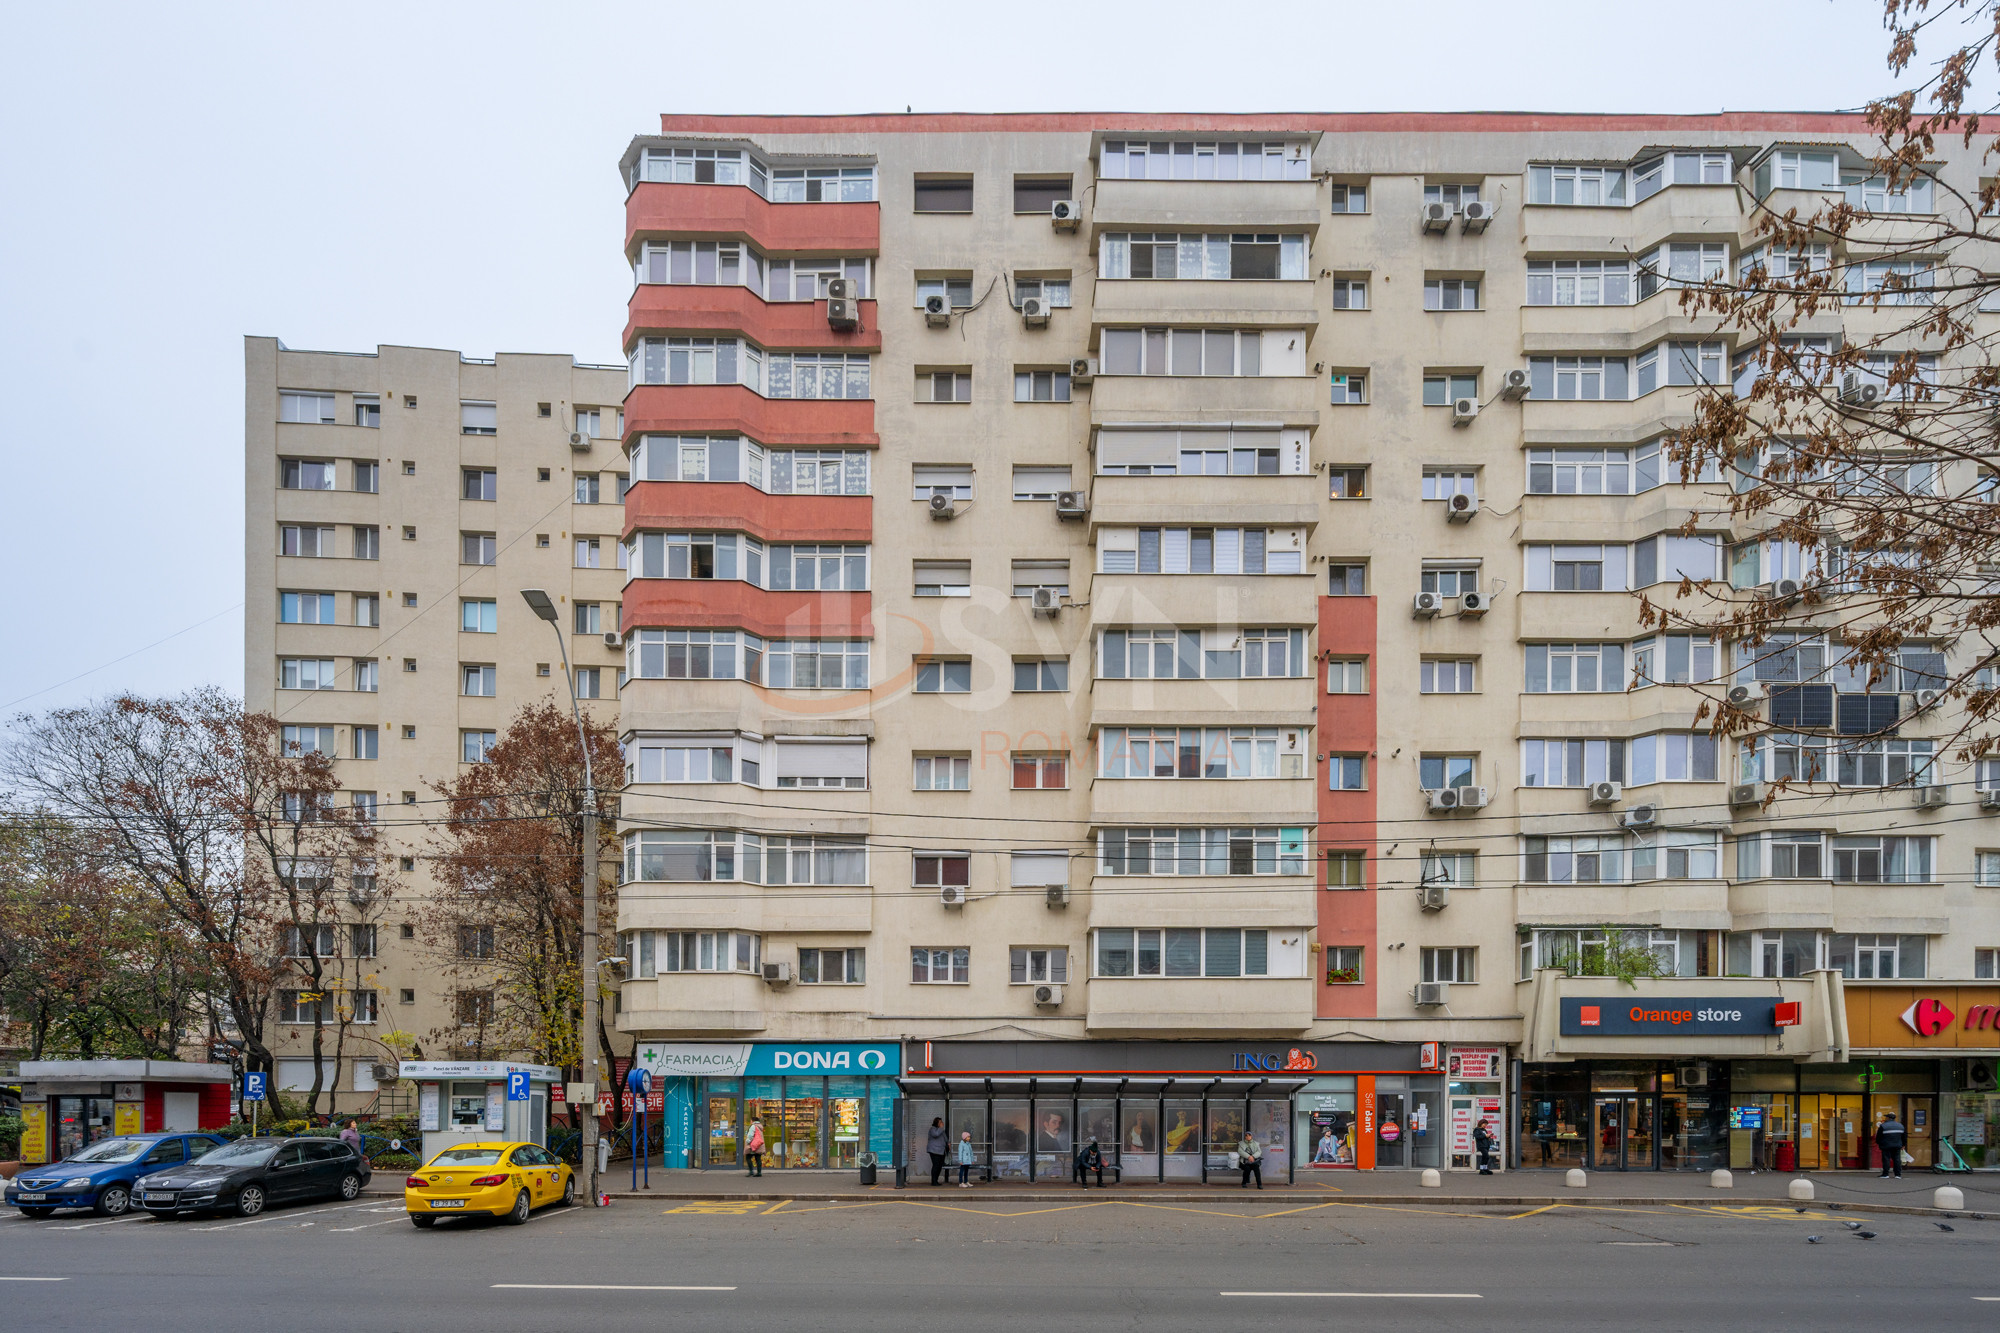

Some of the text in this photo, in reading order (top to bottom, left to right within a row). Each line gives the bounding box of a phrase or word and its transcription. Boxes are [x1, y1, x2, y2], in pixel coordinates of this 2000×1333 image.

[1629, 1006, 1742, 1025] Orange store
[1775, 1018, 1795, 1026] orange
[665, 1054, 735, 1065] FARMACIA
[774, 1051, 850, 1069] DONA
[1232, 1052, 1282, 1071] ING
[248, 1075, 261, 1092] P
[511, 1074, 524, 1094] P
[1364, 1092, 1374, 1134] Self Bank
